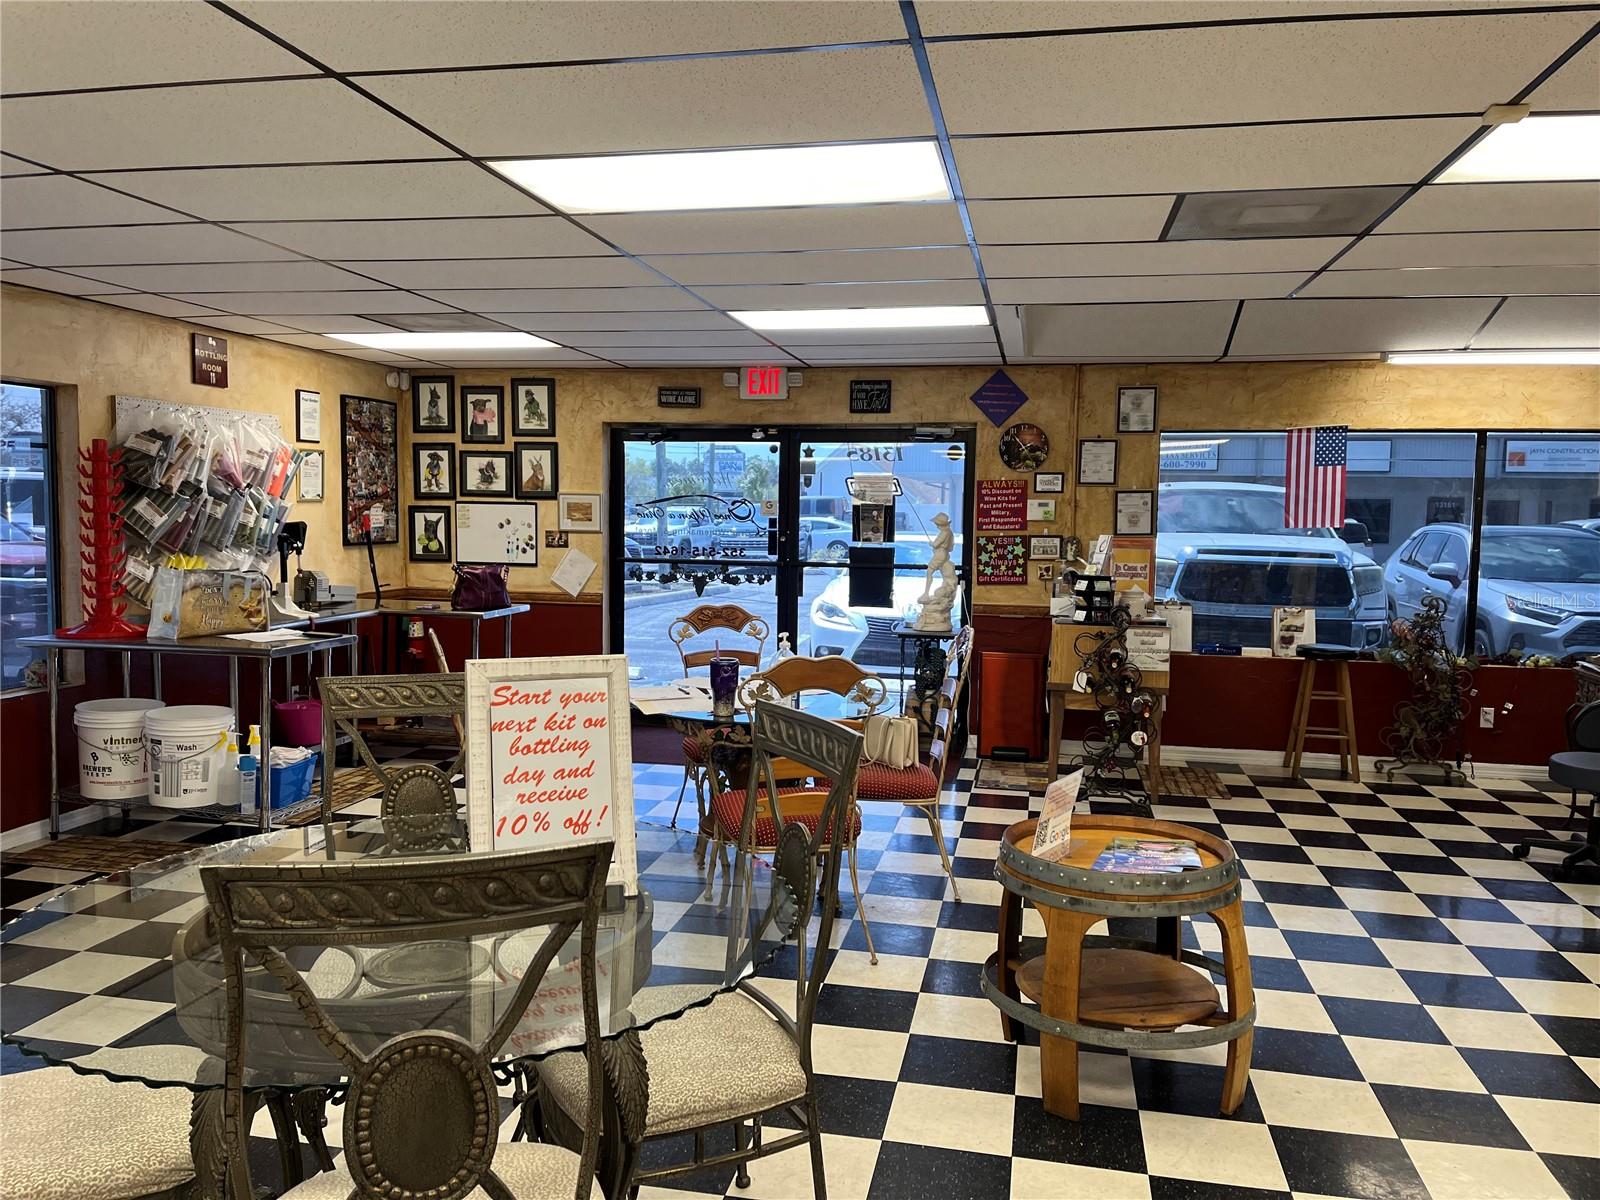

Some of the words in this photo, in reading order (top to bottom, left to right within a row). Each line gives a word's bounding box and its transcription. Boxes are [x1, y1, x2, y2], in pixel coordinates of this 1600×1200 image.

[195, 348, 228, 361] BOTTLING
[202, 362, 222, 373] ROOM
[747, 367, 783, 395] EXIT
[660, 395, 676, 403] WINE
[677, 395, 697, 404] ALONE
[1182, 451, 1217, 459] SERVICES
[1546, 447, 1600, 455] CONSTRUCTION
[990, 559, 1017, 567] Always
[1122, 563, 1138, 571] Case
[1114, 571, 1148, 580] Emergency
[490, 685, 552, 706] Start
[559, 690, 607, 709] your
[491, 715, 537, 734] next
[544, 711, 576, 731] kit
[583, 714, 608, 729] on
[103, 735, 143, 746] vintner
[509, 735, 591, 758] bottling
[82, 764, 112, 773] BREWER'S
[503, 766, 546, 787] day
[552, 760, 596, 780] and
[516, 785, 589, 804] receive
[496, 811, 551, 838] 10%
